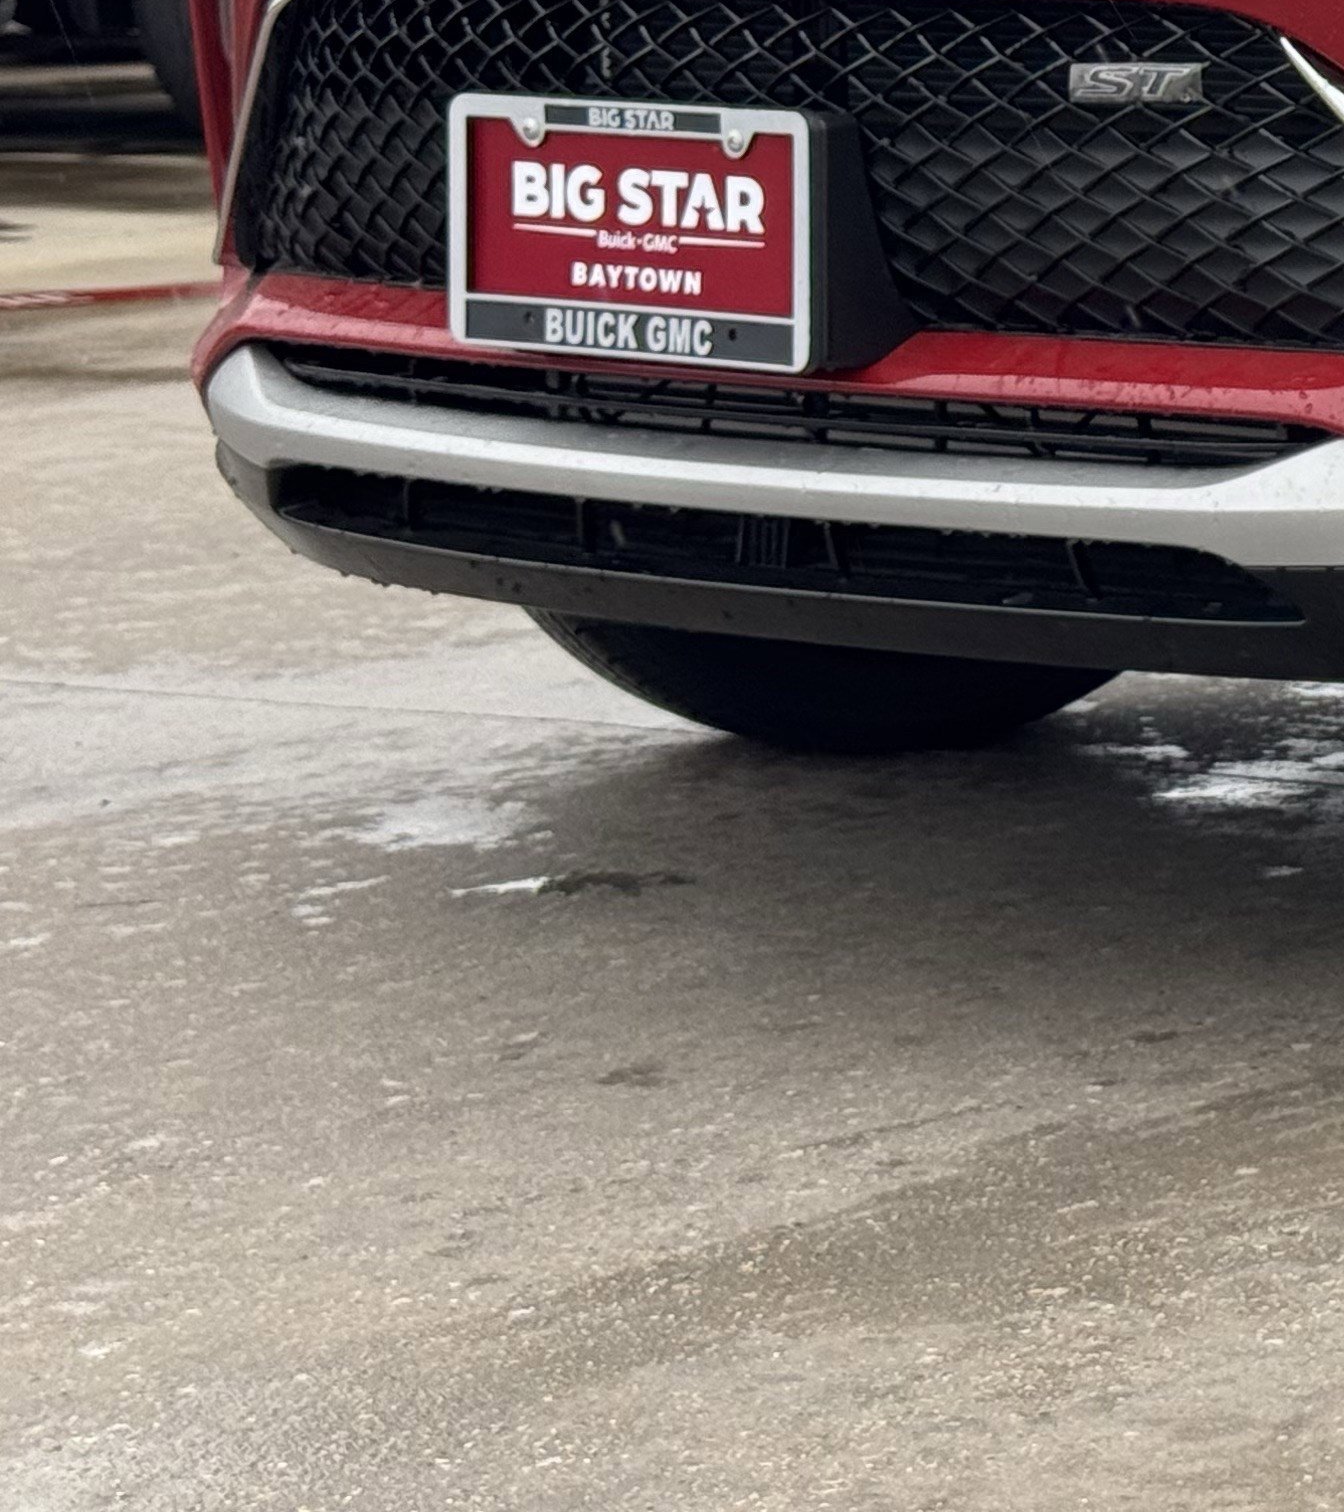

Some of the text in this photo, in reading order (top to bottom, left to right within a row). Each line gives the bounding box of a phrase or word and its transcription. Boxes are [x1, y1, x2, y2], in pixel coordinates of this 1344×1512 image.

[1076, 65, 1191, 97] ST
[588, 106, 674, 131] BIG STAR
[512, 160, 765, 234] BIG STAR
[597, 230, 678, 254] Buick GMC
[571, 262, 702, 295] BAYTOWN
[545, 308, 713, 356] BUICK GMC
